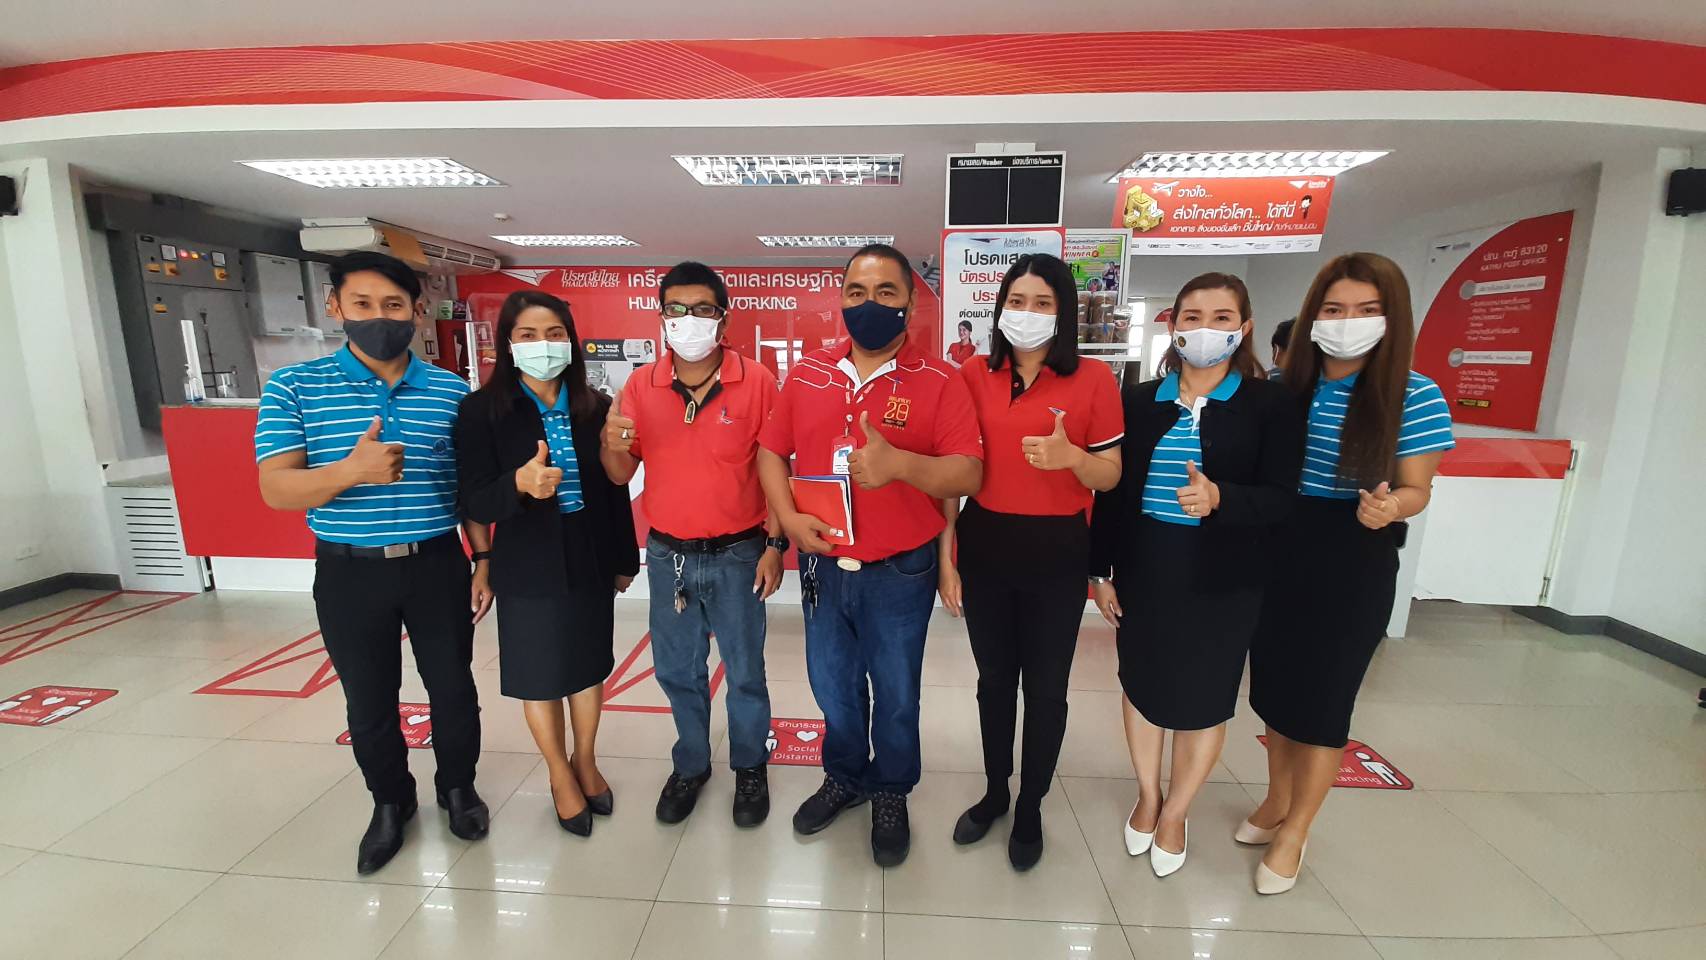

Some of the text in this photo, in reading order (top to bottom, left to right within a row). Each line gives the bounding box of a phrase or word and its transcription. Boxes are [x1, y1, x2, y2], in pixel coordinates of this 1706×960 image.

[964, 248, 1021, 266] โปรดแส
[600, 280, 621, 288] POST
[787, 744, 819, 753] Social
